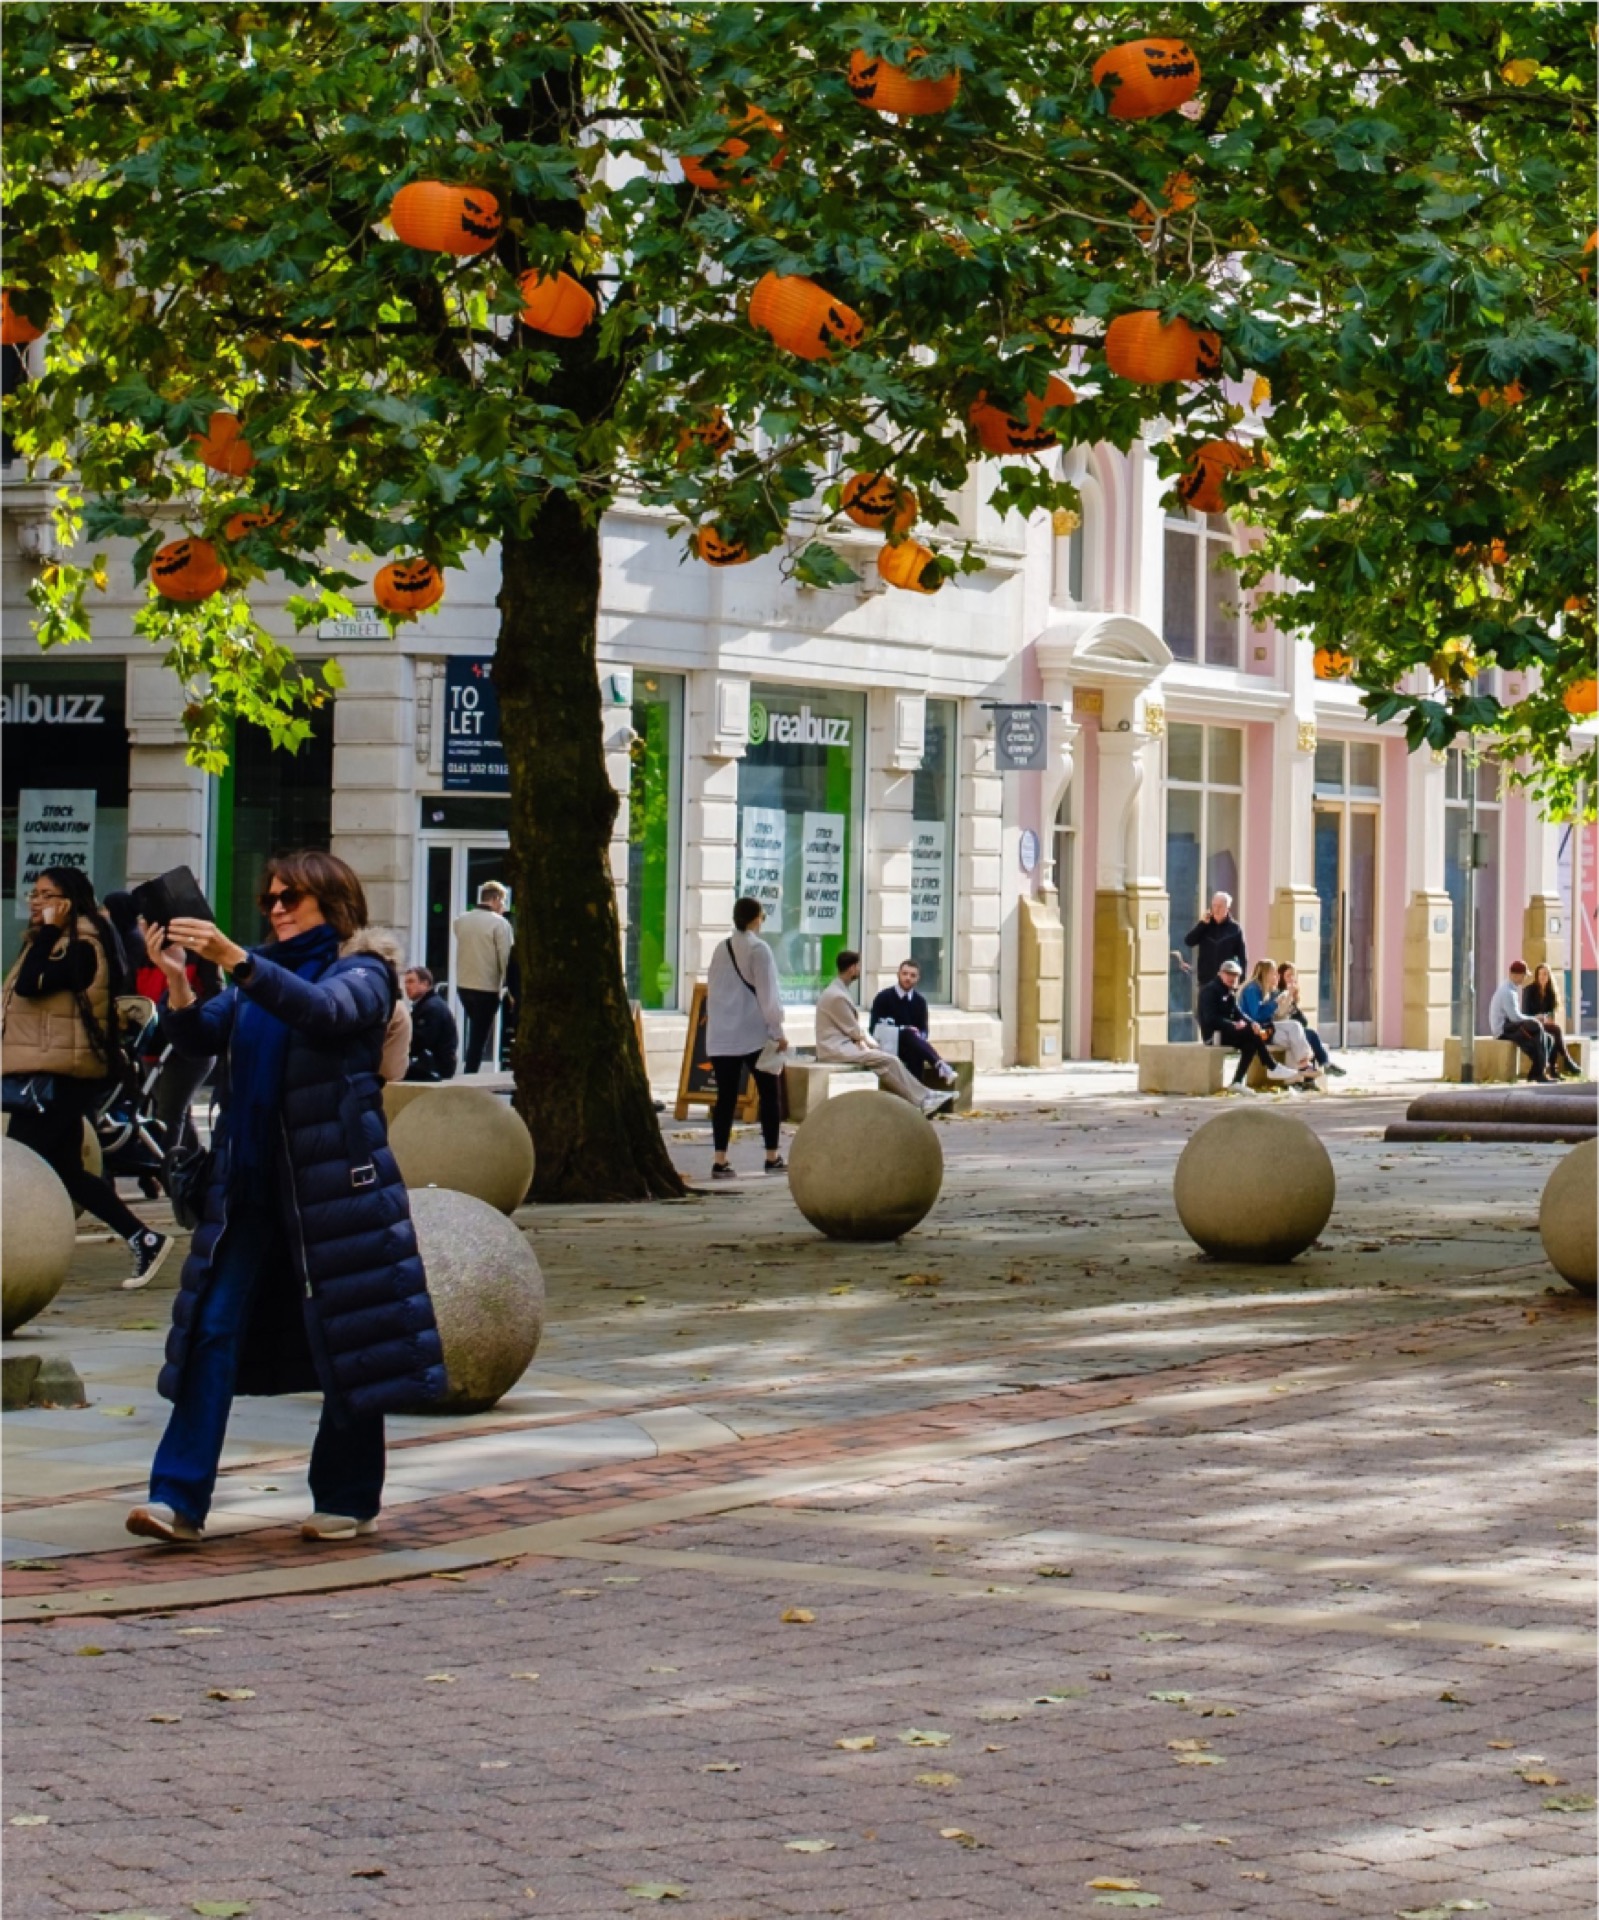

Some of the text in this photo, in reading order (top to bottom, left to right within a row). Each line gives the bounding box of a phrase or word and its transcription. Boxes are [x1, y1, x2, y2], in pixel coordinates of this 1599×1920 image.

[335, 622, 381, 636] STREET
[450, 685, 480, 710] TO
[450, 711, 485, 735] LET
[768, 705, 851, 747] realbuzz
[42, 805, 74, 817] STOCK
[24, 820, 90, 834] LIQUIDATION
[25, 853, 86, 867] ALL STOCK
[819, 872, 839, 884] STOCK
[820, 889, 840, 902] PRICE
